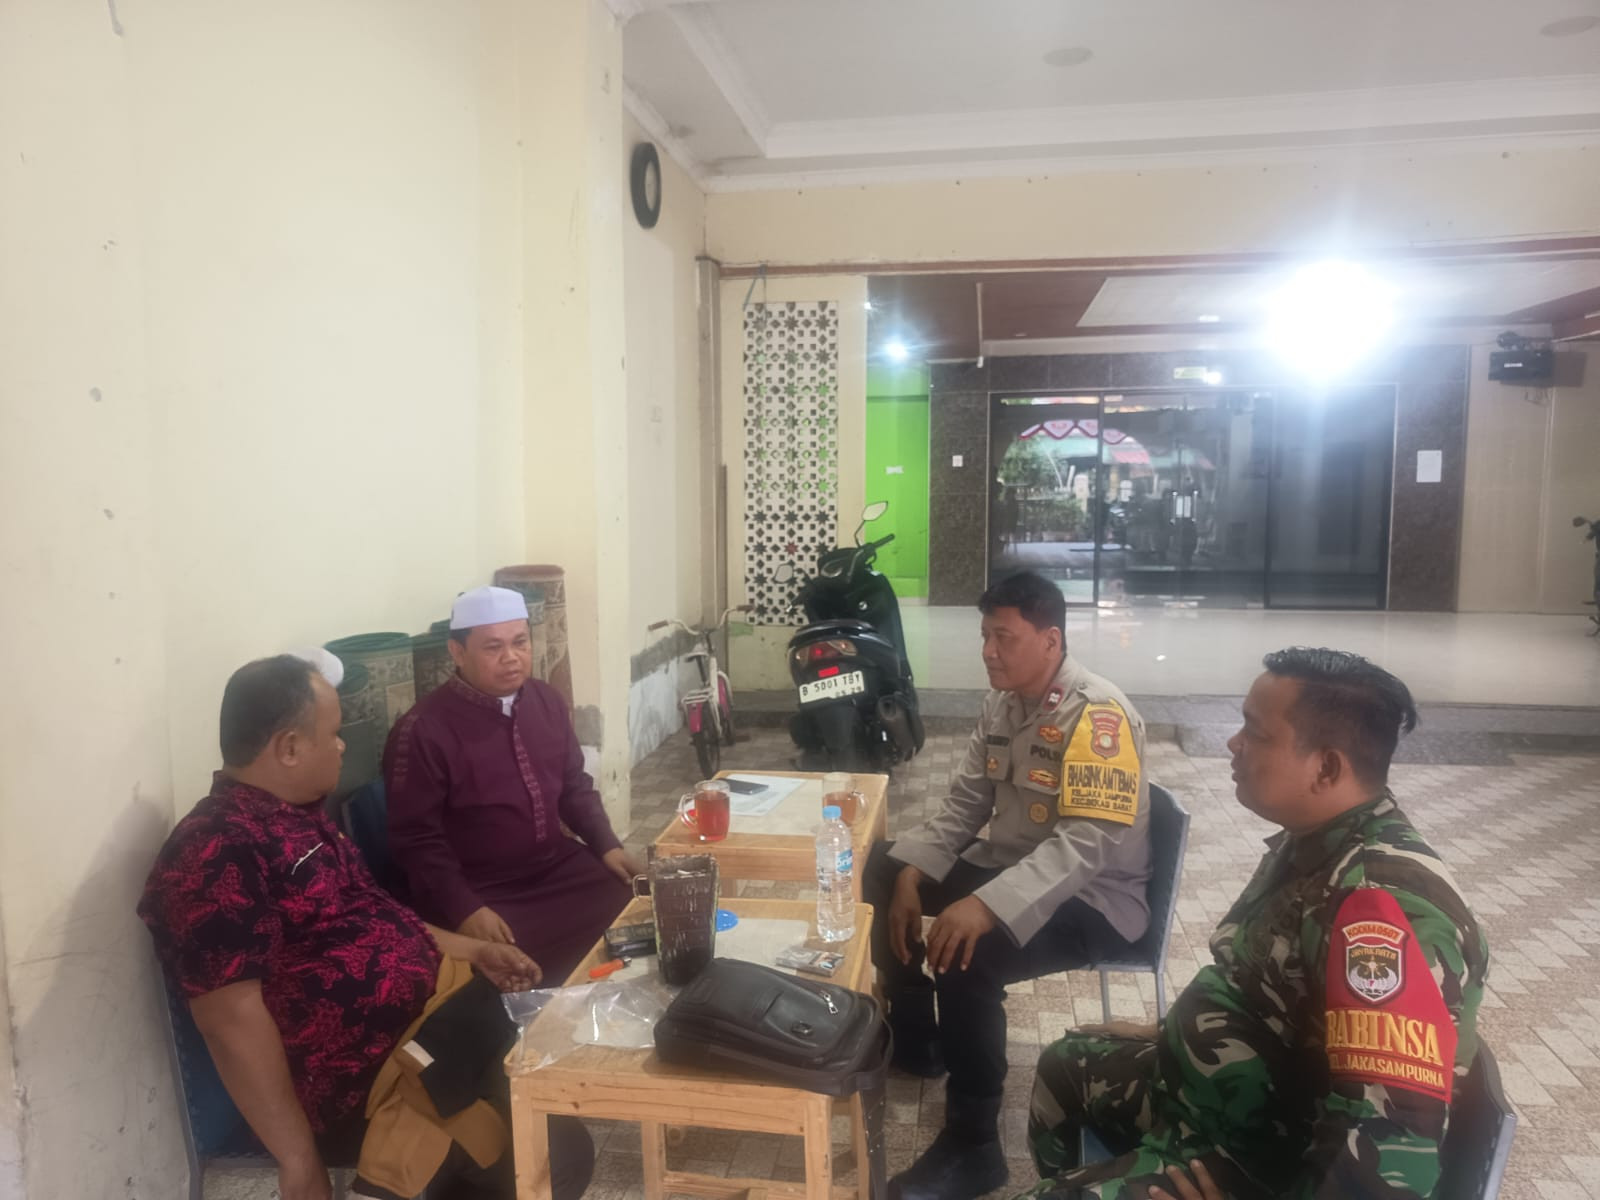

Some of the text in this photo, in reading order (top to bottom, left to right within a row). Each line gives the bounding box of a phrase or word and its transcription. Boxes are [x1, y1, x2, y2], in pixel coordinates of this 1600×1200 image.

[802, 686, 809, 697] B
[814, 678, 838, 693] 5001
[1325, 1009, 1444, 1067] BABINSA
[1344, 1053, 1446, 1089] JAKASAMPURNA
